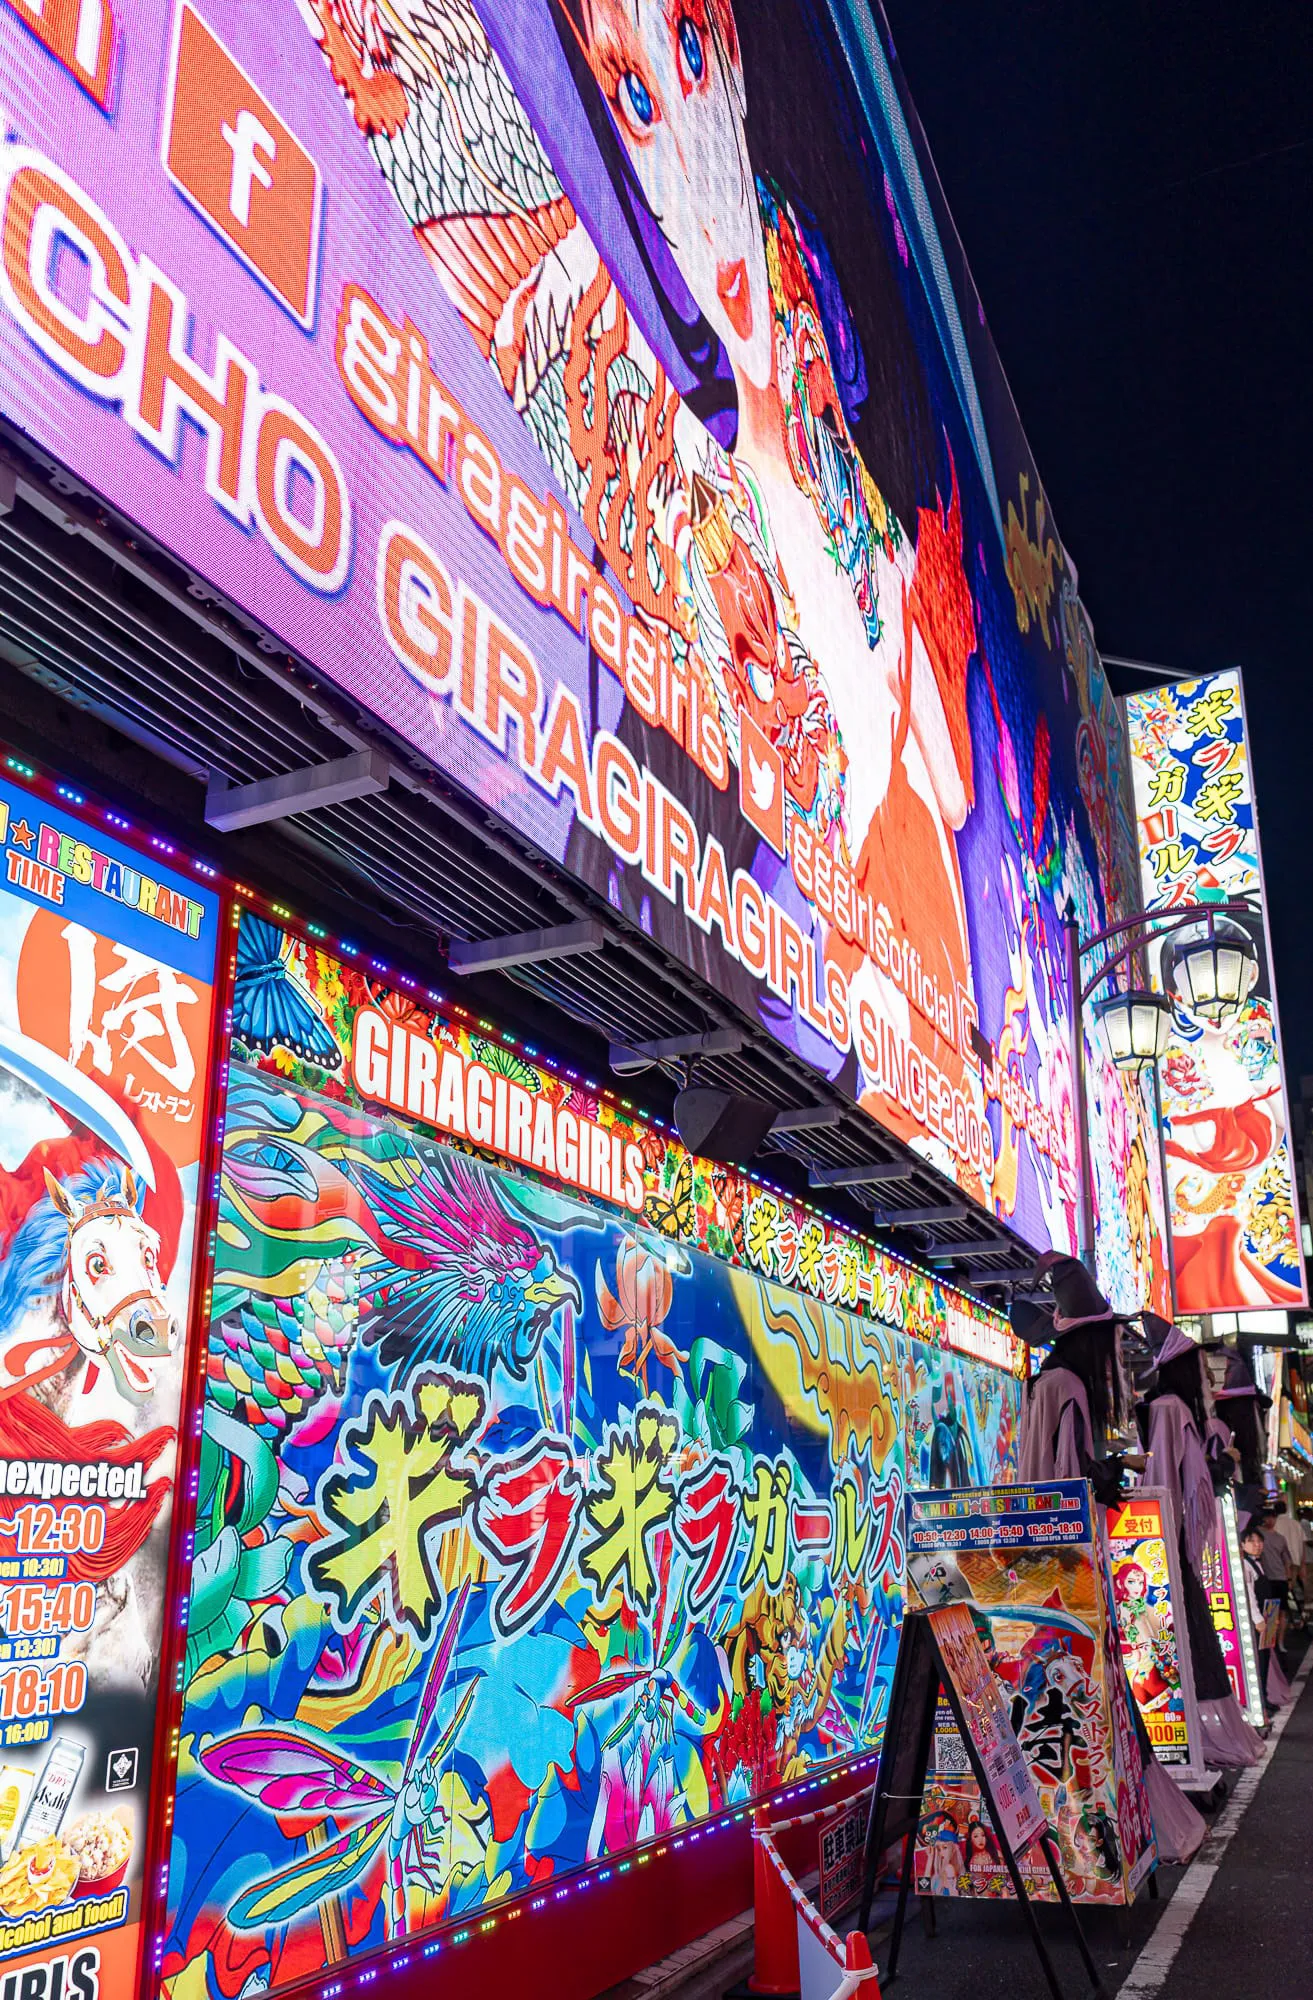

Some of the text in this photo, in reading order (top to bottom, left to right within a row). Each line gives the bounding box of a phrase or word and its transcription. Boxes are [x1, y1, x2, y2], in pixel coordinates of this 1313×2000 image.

[338, 288, 731, 789] giragiragirls
[376, 520, 852, 1053] GIRAGIRAGIRLS
[1184, 688, 1247, 865] ギラギラ
[7, 852, 64, 902] TIME
[38, 824, 204, 938] RESTAURANT
[791, 820, 958, 1045] gggirlsofficial
[123, 1073, 195, 1123] レストラン
[353, 1007, 645, 1213] GIRAGIRAGIRLS
[747, 1196, 904, 1325] ギラギラガールズ
[312, 1372, 904, 1643] ギラギラガールズ
[981, 1493, 1062, 1514] RESTAURANT
[1062, 1499, 1079, 1508] TIME
[1123, 1517, 1154, 1534] 受付
[22, 1558, 65, 1576] 10:30)
[14, 1638, 57, 1658] 13:30)
[5, 1721, 49, 1744] 16:00)
[1010, 1686, 1089, 1784] 侍
[1074, 1677, 1109, 1789] レストラン
[34, 1785, 71, 1811] Asahi
[822, 1808, 867, 1876] 駐車禁止
[52, 1905, 84, 1936] and
[84, 1893, 125, 1926] food!
